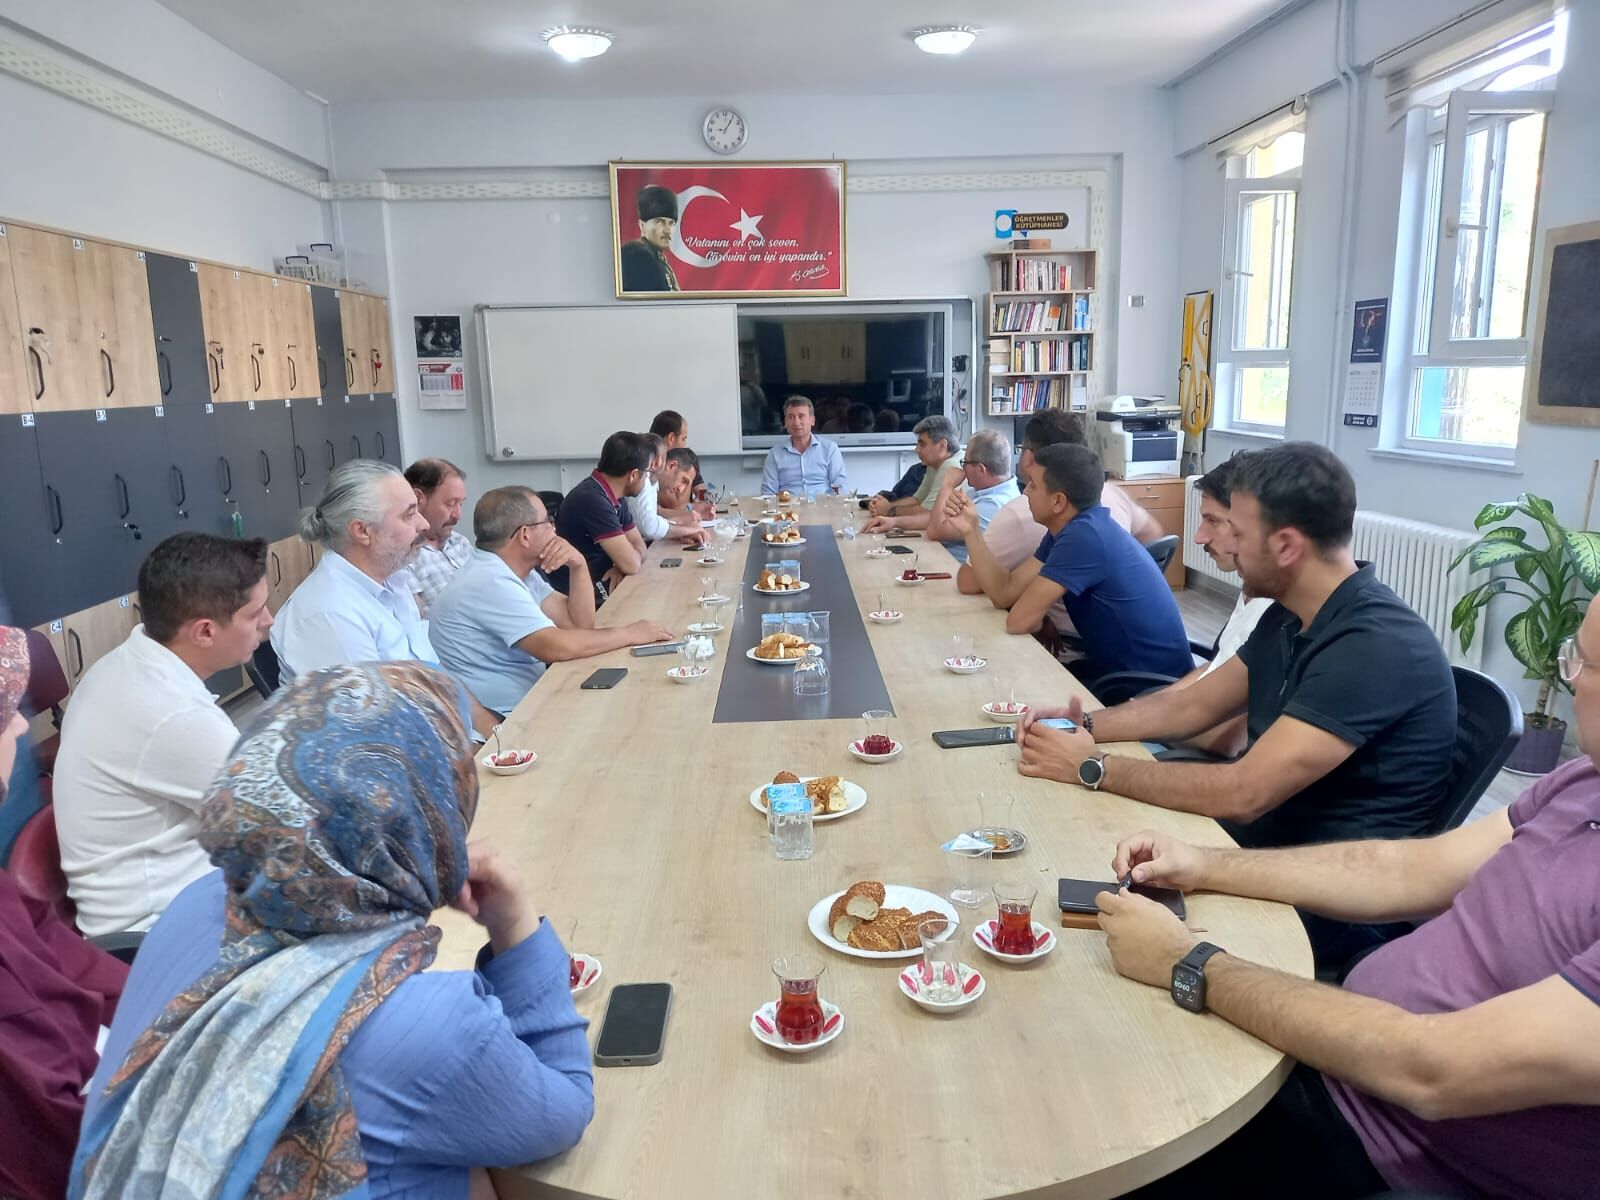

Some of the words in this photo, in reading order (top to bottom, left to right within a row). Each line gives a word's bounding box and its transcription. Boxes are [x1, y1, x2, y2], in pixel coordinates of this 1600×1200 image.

[1014, 215, 1064, 223] ÖĞRETMENLER
[732, 239, 745, 248] en
[747, 238, 766, 250] çok
[705, 249, 747, 262] Görevini
[749, 253, 760, 262] en
[763, 251, 778, 263] iyi
[23, 415, 34, 425] B-4
